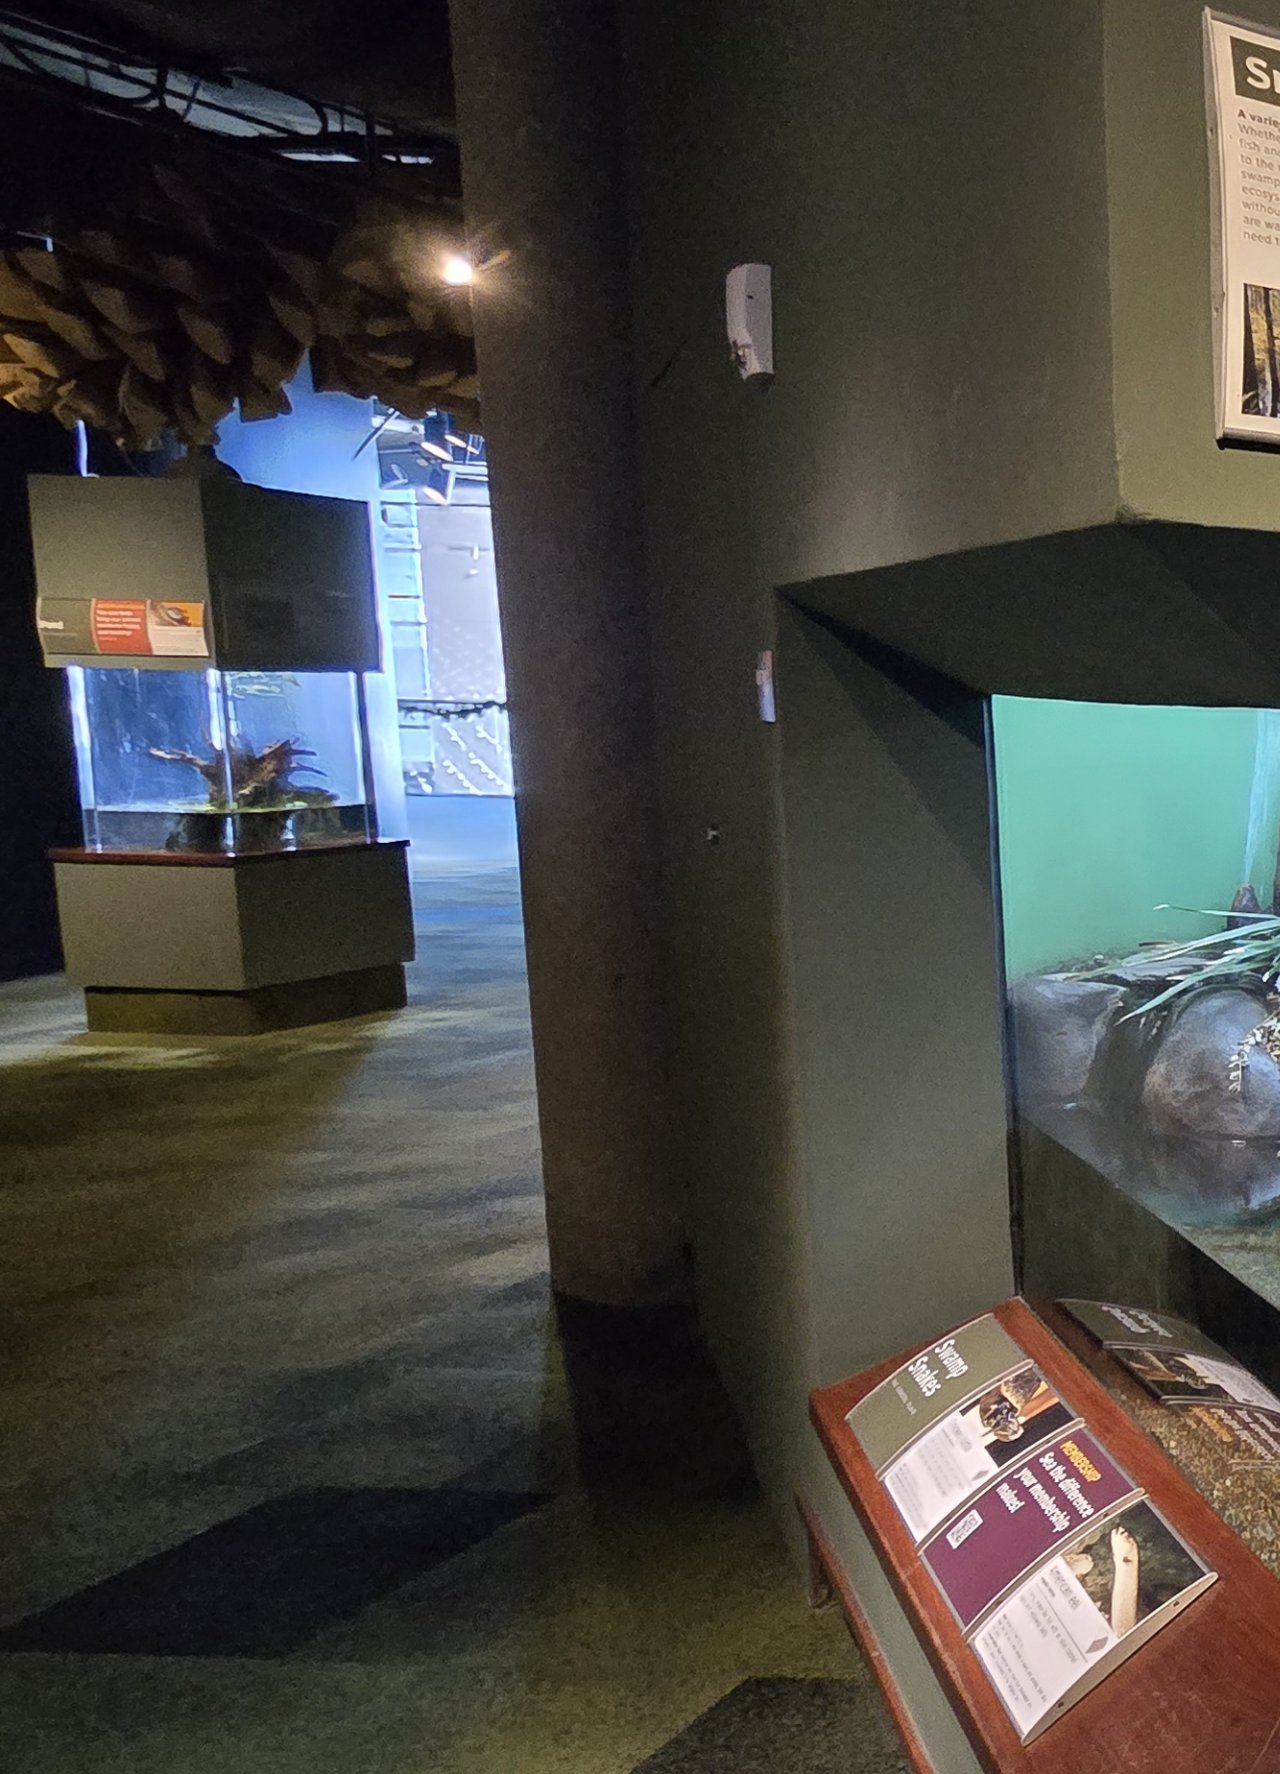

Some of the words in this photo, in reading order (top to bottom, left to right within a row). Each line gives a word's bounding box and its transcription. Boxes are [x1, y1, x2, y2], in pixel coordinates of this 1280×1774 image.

[1238, 109, 1246, 119] A
[1240, 138, 1260, 152] fish
[1240, 154, 1252, 165] to
[1256, 157, 1274, 171] the
[1243, 216, 1260, 226] are
[1243, 230, 1272, 245] need
[935, 1339, 968, 1379] Swamp
[908, 1356, 941, 1397] Snakes
[1060, 1440, 1101, 1482] MEMBERSHIP
[1039, 1452, 1057, 1471] Sea
[1049, 1465, 1067, 1483] the
[1058, 1478, 1094, 1518] difference
[1013, 1467, 1038, 1487] your
[1029, 1483, 1070, 1533] membership
